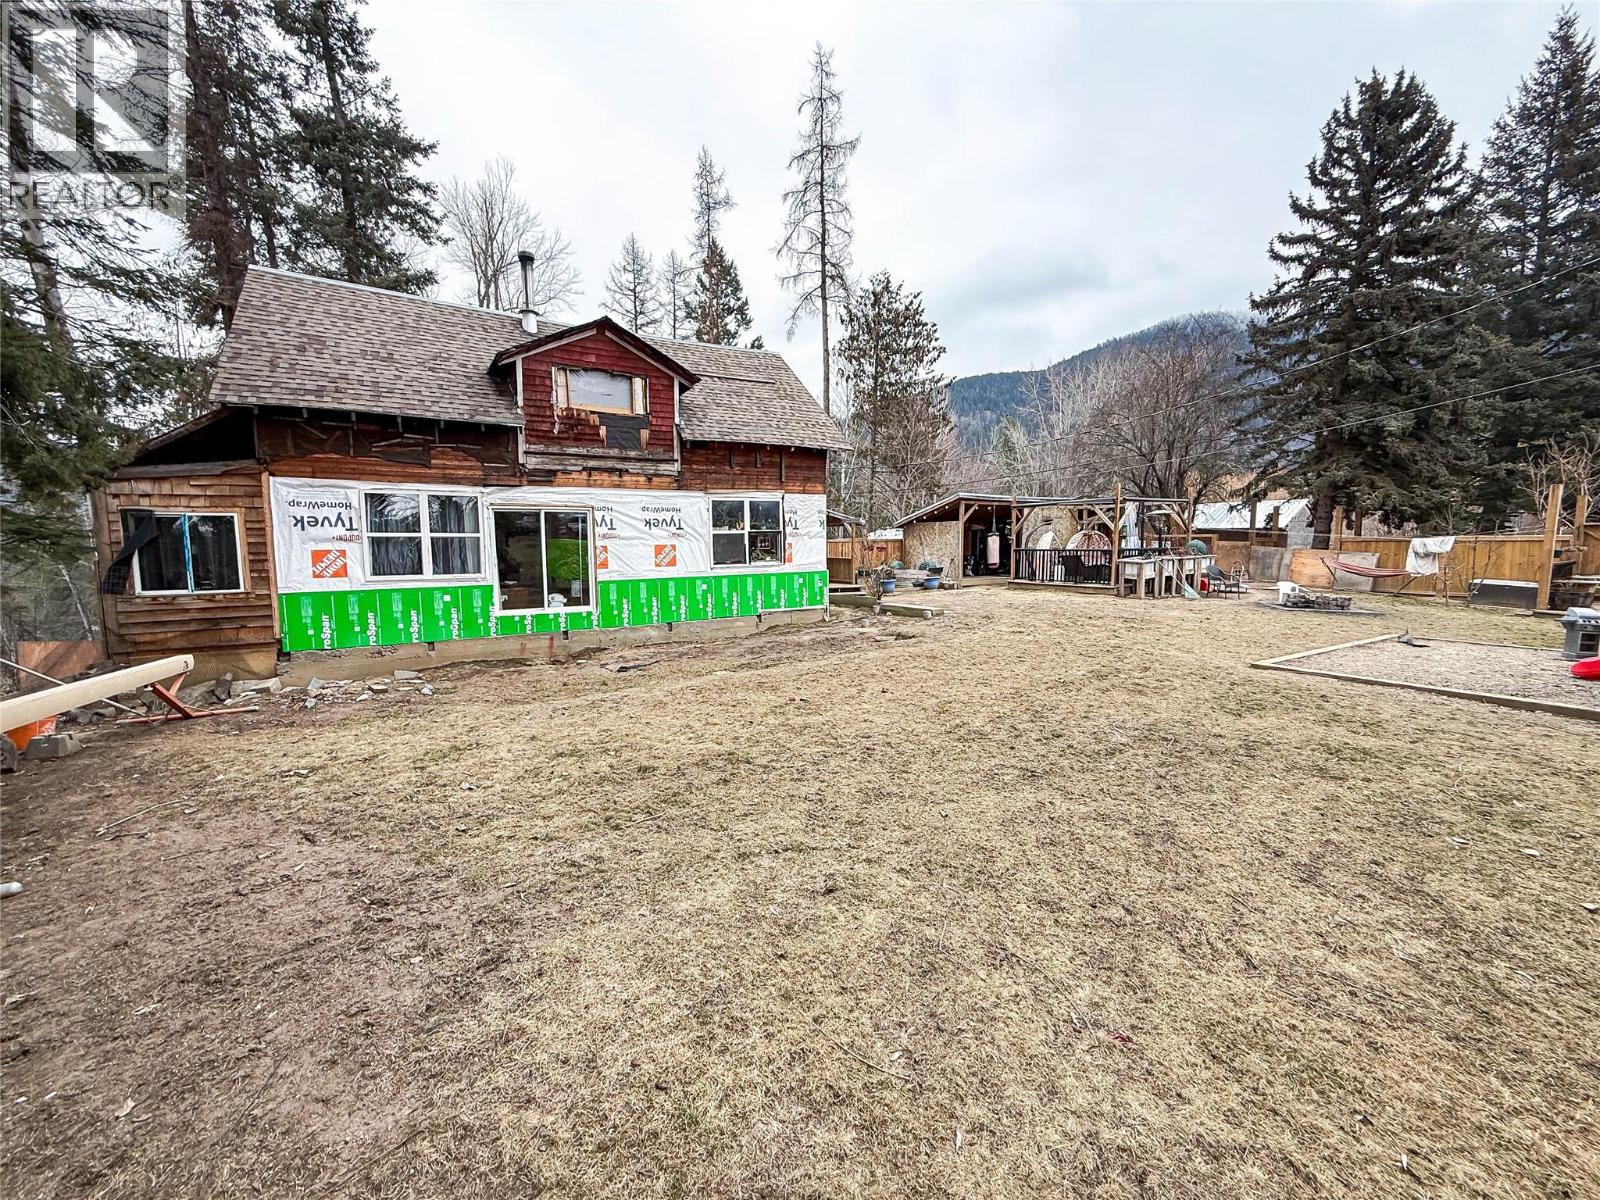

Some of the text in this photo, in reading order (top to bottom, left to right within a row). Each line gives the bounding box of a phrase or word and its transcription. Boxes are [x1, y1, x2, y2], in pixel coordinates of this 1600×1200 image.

[288, 499, 352, 510] HomeWrap
[641, 505, 681, 514] HomeWrap
[292, 512, 359, 531] Tyvek
[644, 515, 684, 531] Tyvek
[312, 549, 341, 575] DEPOT
[320, 555, 347, 577] HOME
